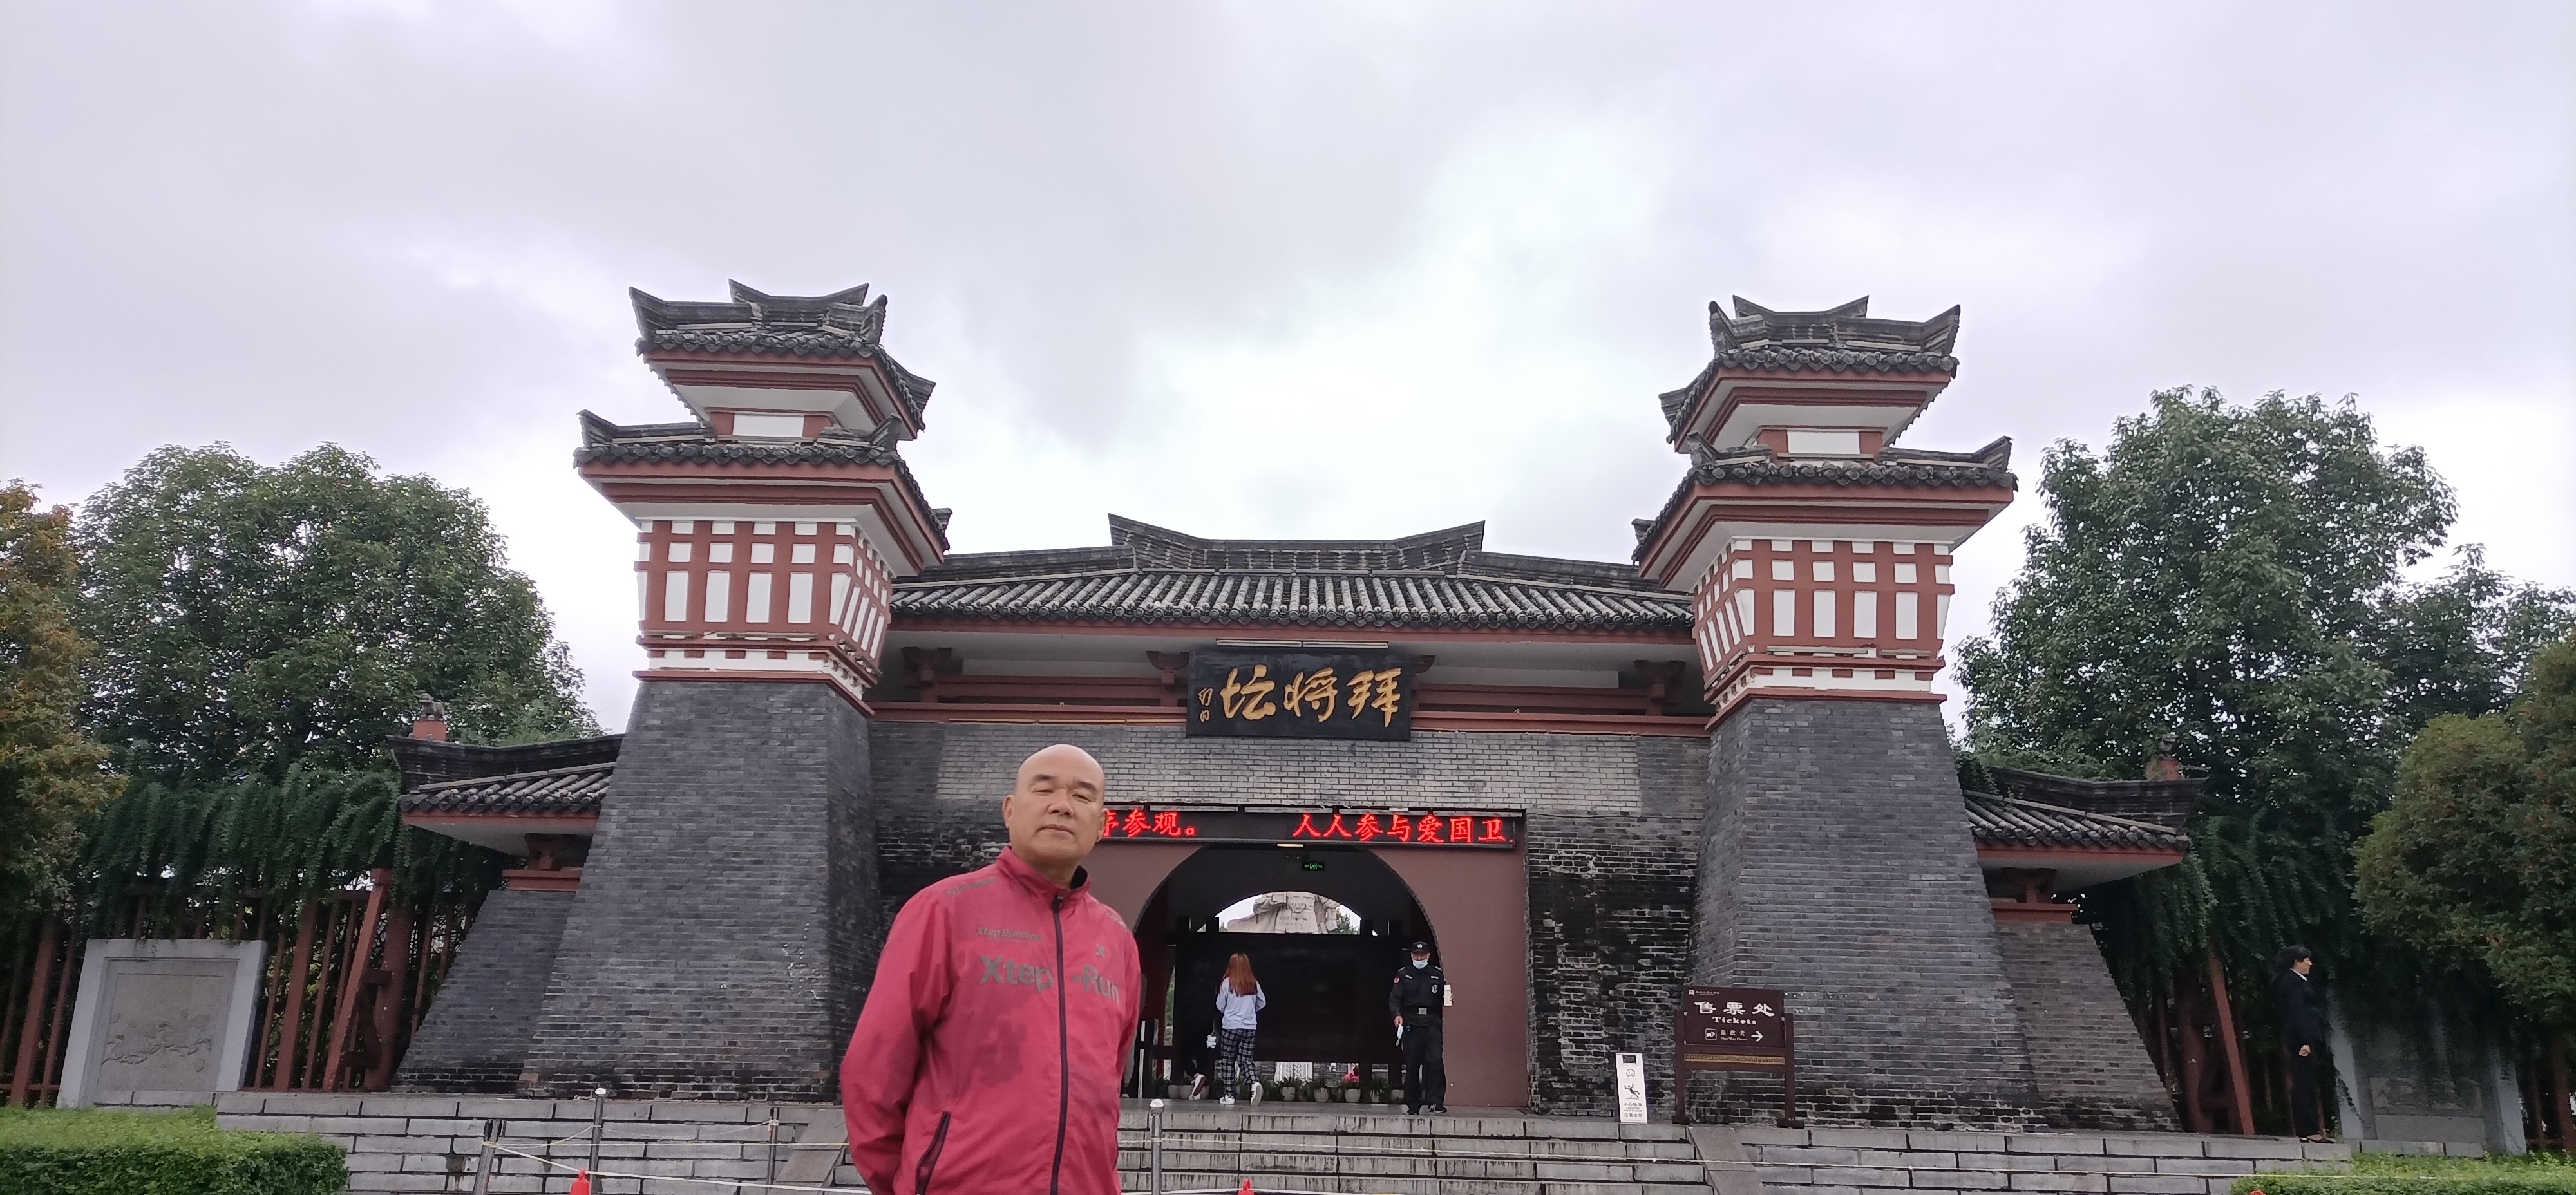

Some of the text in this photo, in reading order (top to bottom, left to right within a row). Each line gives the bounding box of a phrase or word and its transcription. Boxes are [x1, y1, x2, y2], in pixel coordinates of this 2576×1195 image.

[1292, 813, 1513, 843] 人人参与爱国卫
[978, 954, 1054, 993] Xtep
[1694, 1001, 1775, 1017] 售票处
